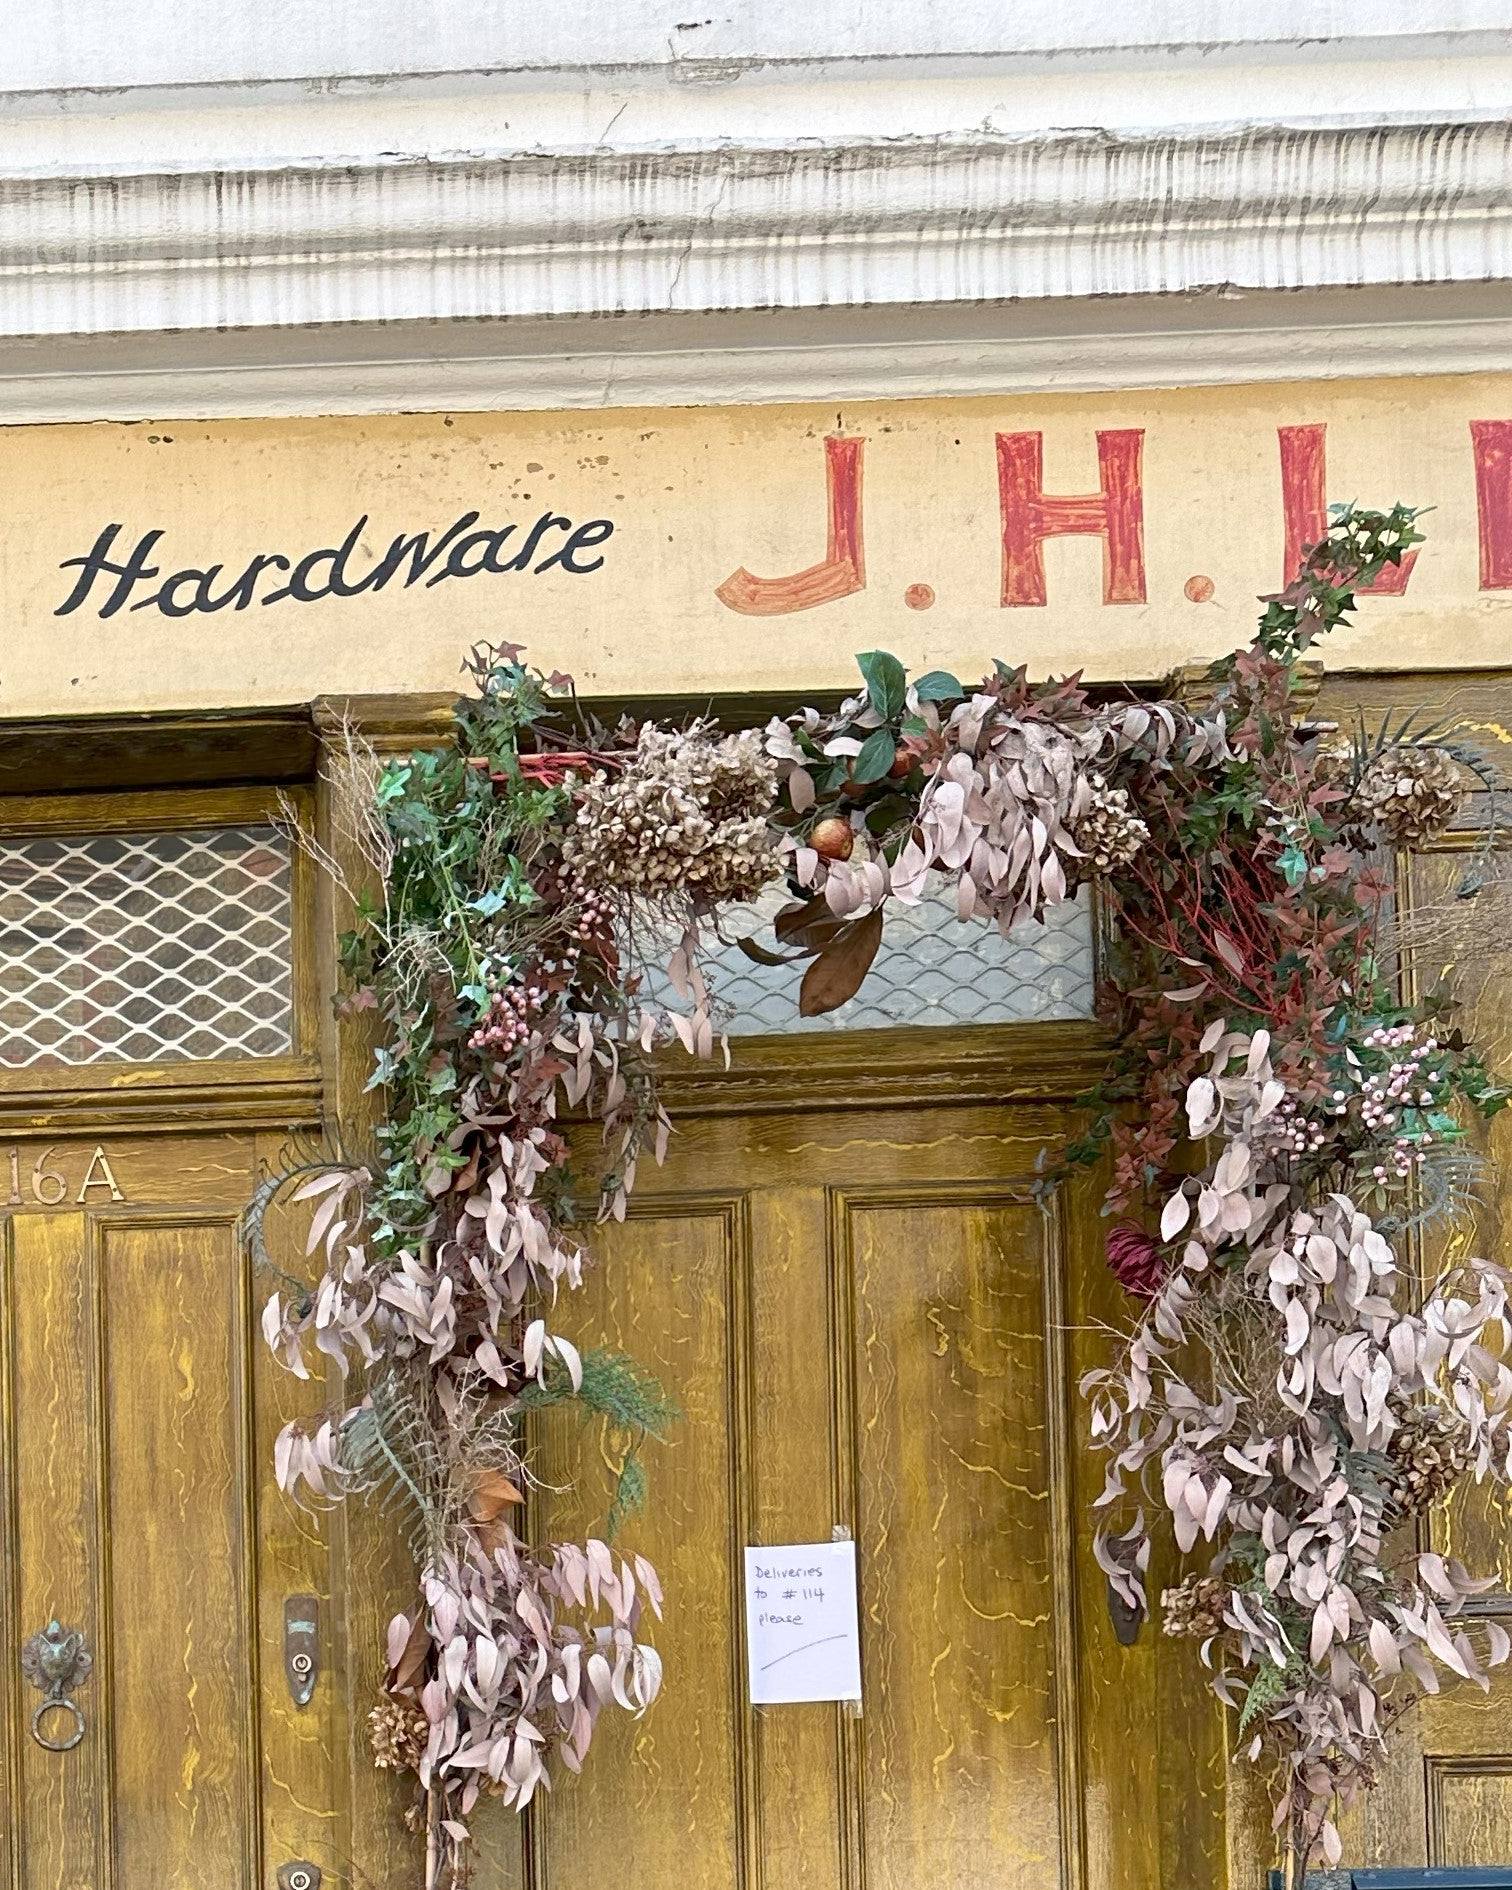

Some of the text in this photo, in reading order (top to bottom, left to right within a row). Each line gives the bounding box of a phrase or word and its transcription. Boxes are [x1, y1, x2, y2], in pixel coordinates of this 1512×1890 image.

[53, 510, 615, 619] Hardware
[754, 1565, 823, 1579] Deliveries
[754, 1586, 768, 1599] to
[758, 1612, 804, 1627] please
